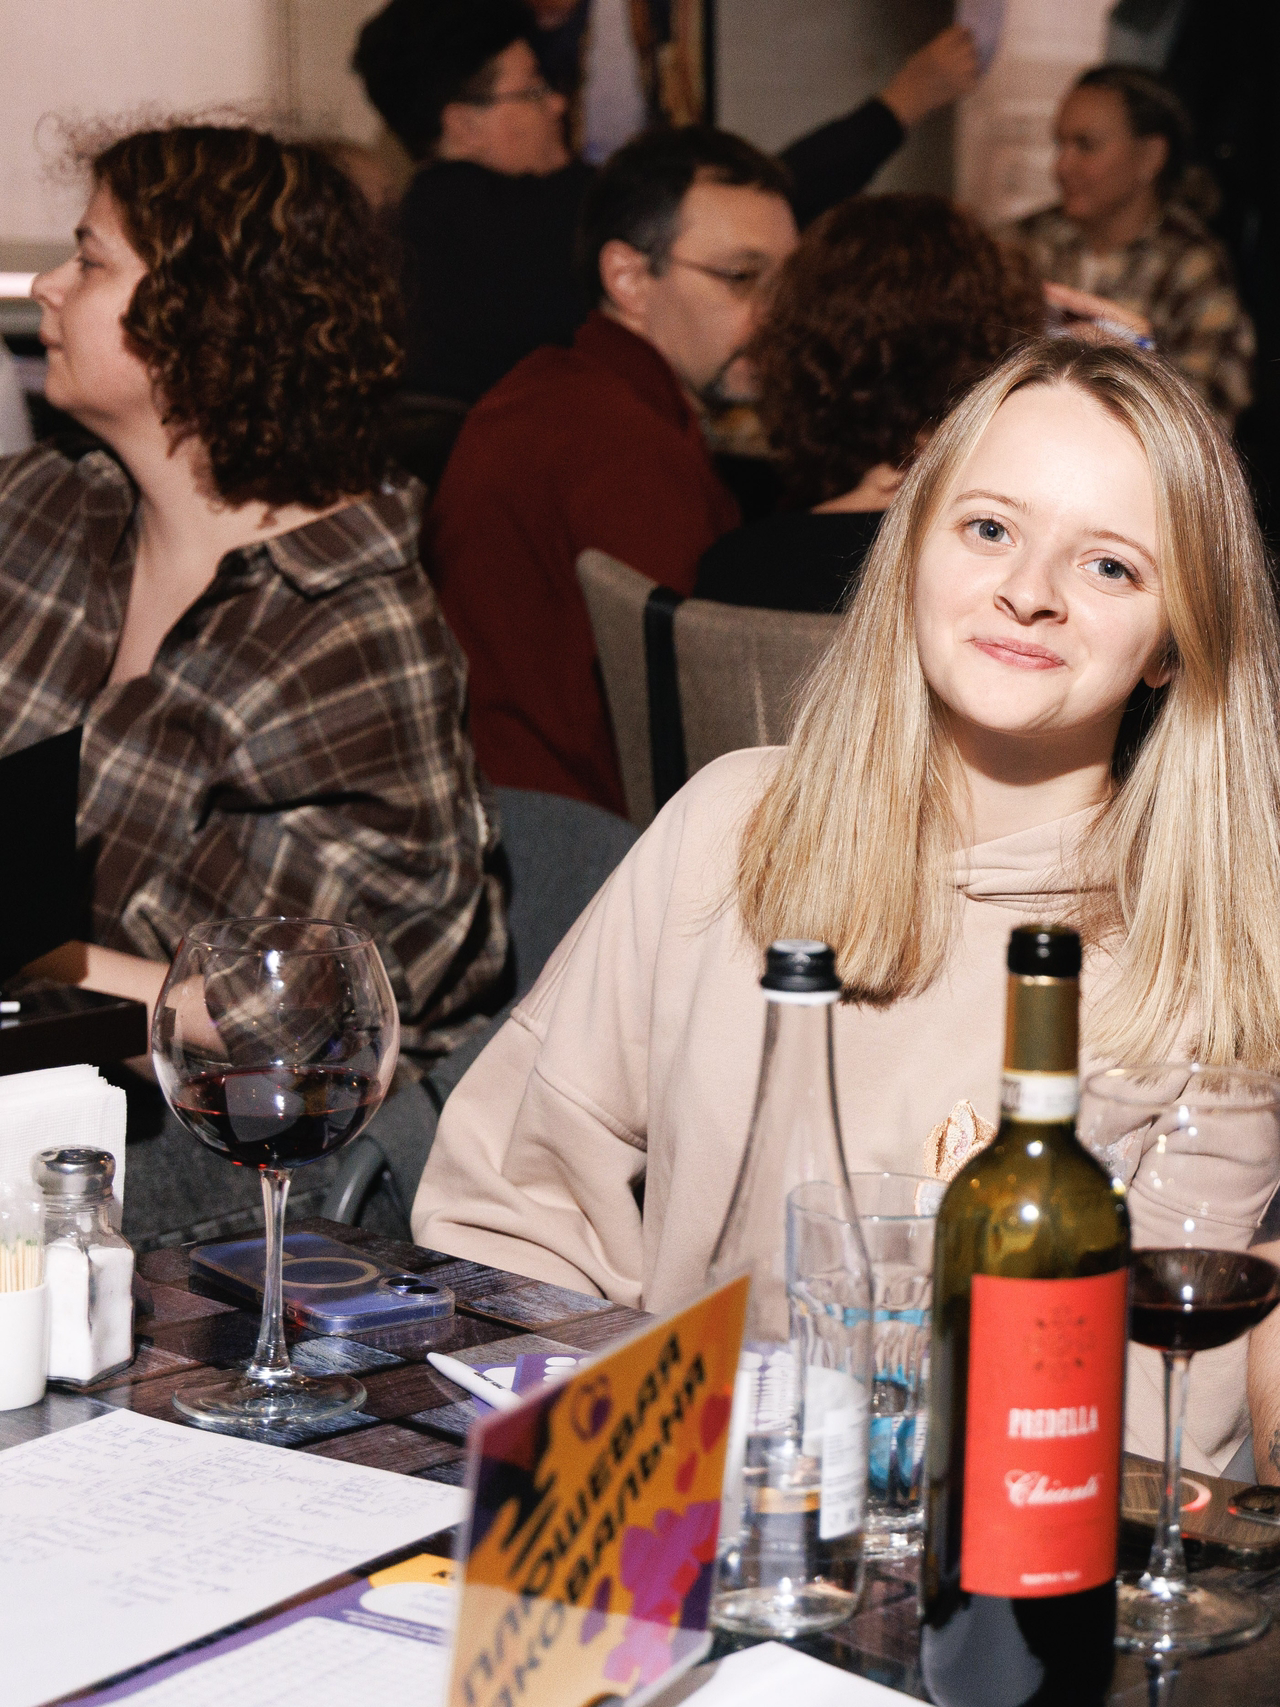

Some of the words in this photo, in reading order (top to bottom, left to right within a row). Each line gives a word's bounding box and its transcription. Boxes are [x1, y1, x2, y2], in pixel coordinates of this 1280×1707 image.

[1008, 1405, 1099, 1439] PREDELLA
[1004, 1468, 1100, 1507] Chianti
[462, 1331, 682, 1705] ПЛЮШЕВАЯ
